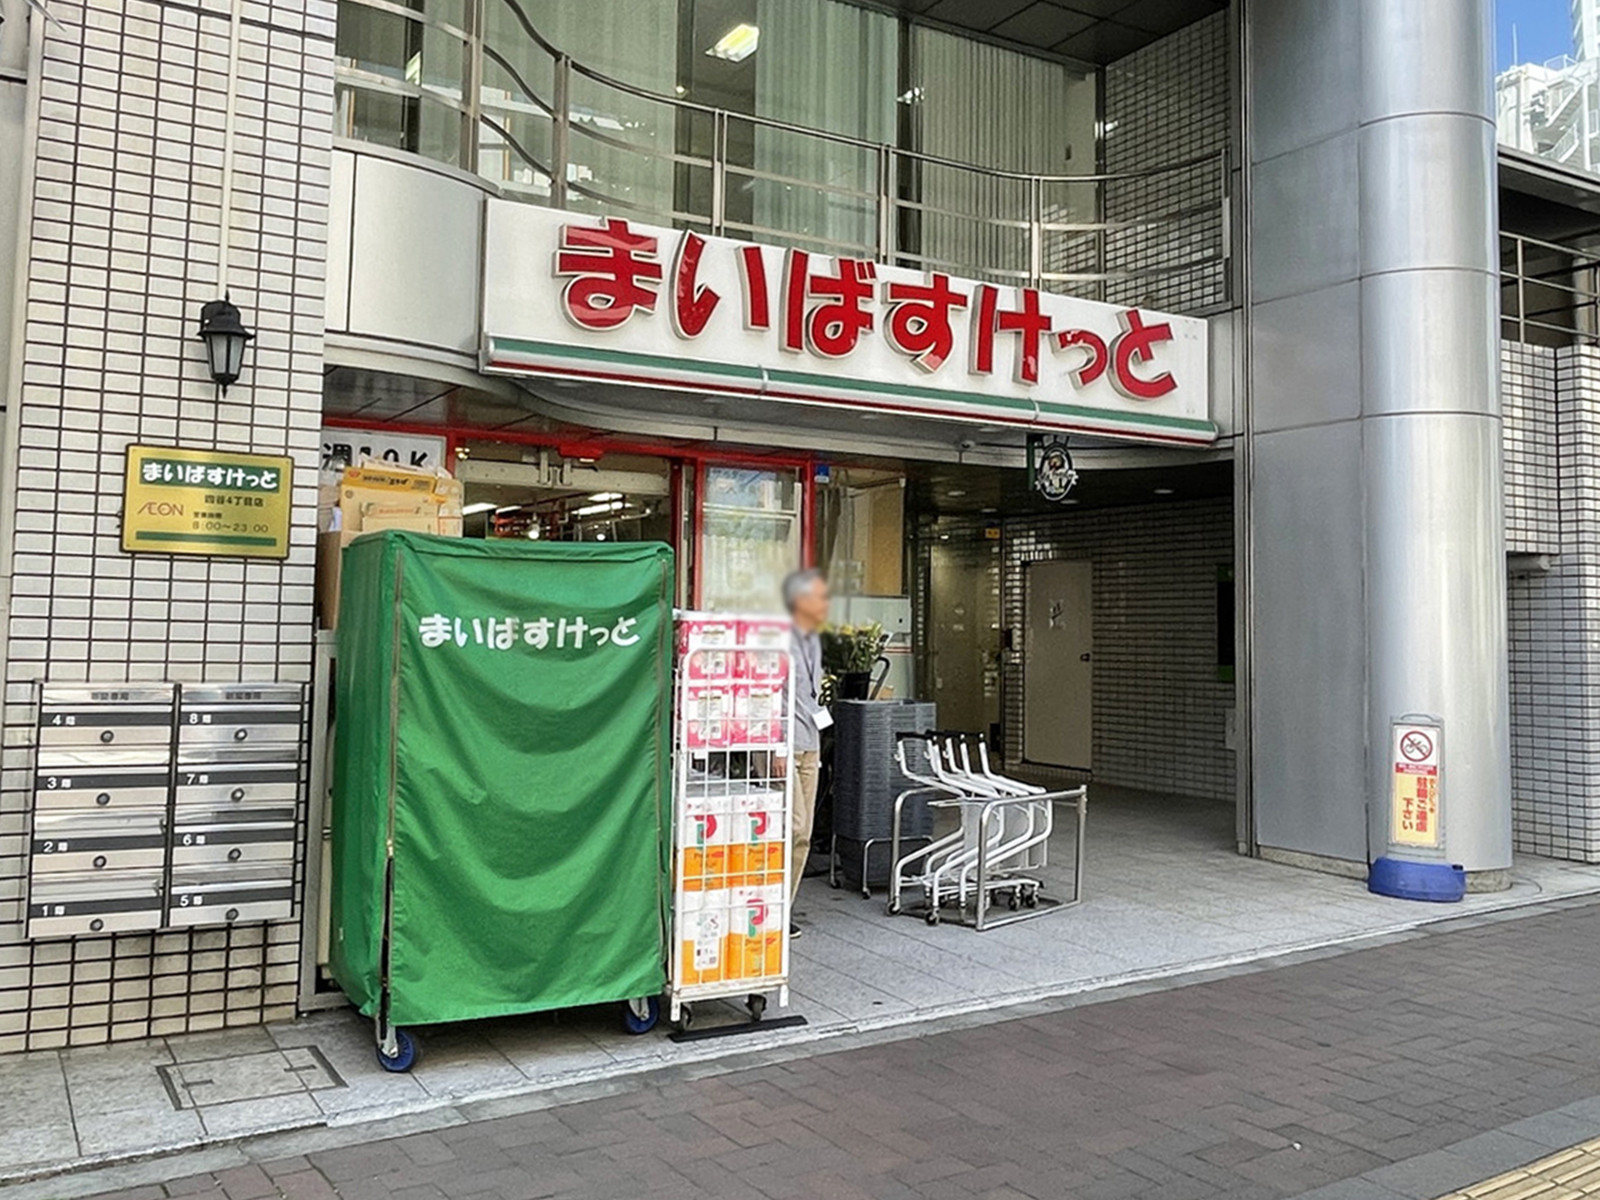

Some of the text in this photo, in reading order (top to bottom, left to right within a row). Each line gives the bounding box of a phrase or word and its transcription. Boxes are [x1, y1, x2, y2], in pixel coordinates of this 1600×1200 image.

[553, 217, 1178, 398] まいばすけっと
[142, 463, 278, 489] まいばすけっと
[419, 614, 641, 650] まいばすけっと
